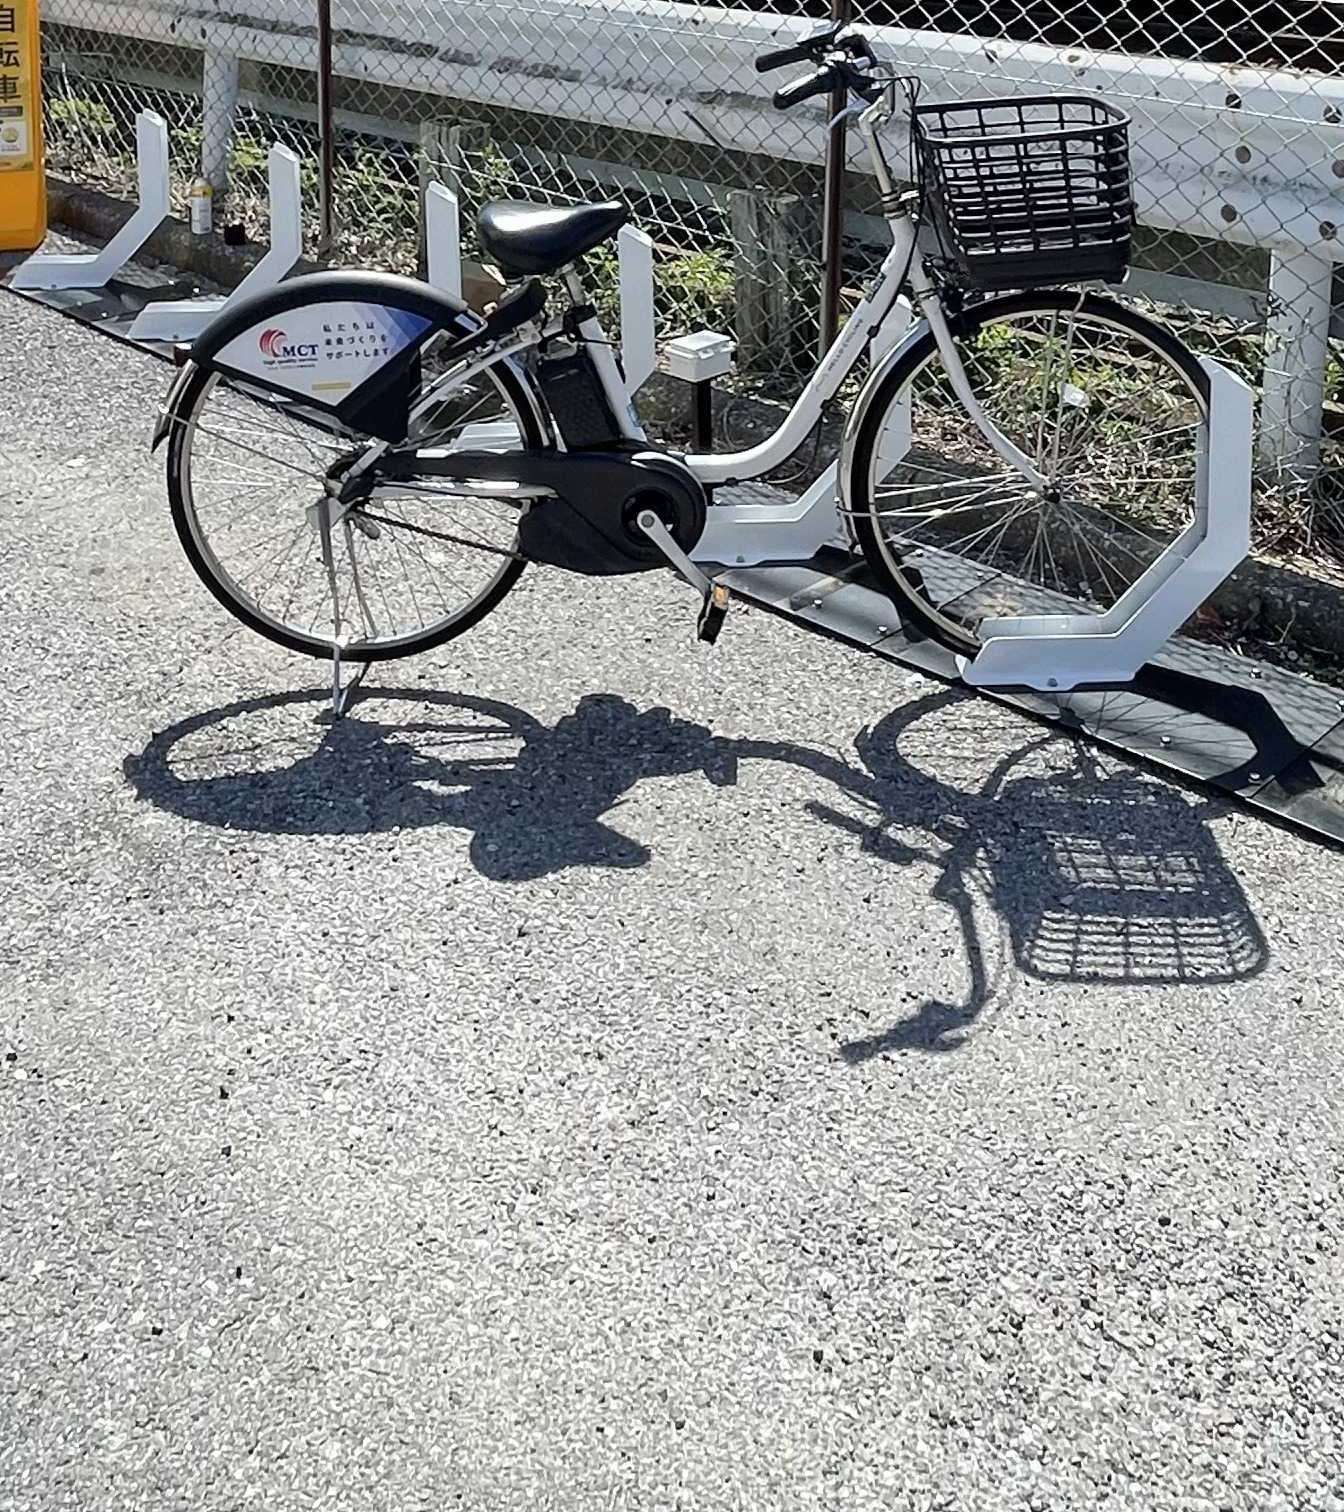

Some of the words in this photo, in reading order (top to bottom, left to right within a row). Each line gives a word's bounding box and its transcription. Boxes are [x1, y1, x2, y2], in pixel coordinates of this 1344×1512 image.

[282, 344, 319, 357] MCT
[325, 347, 390, 360] サポートします
